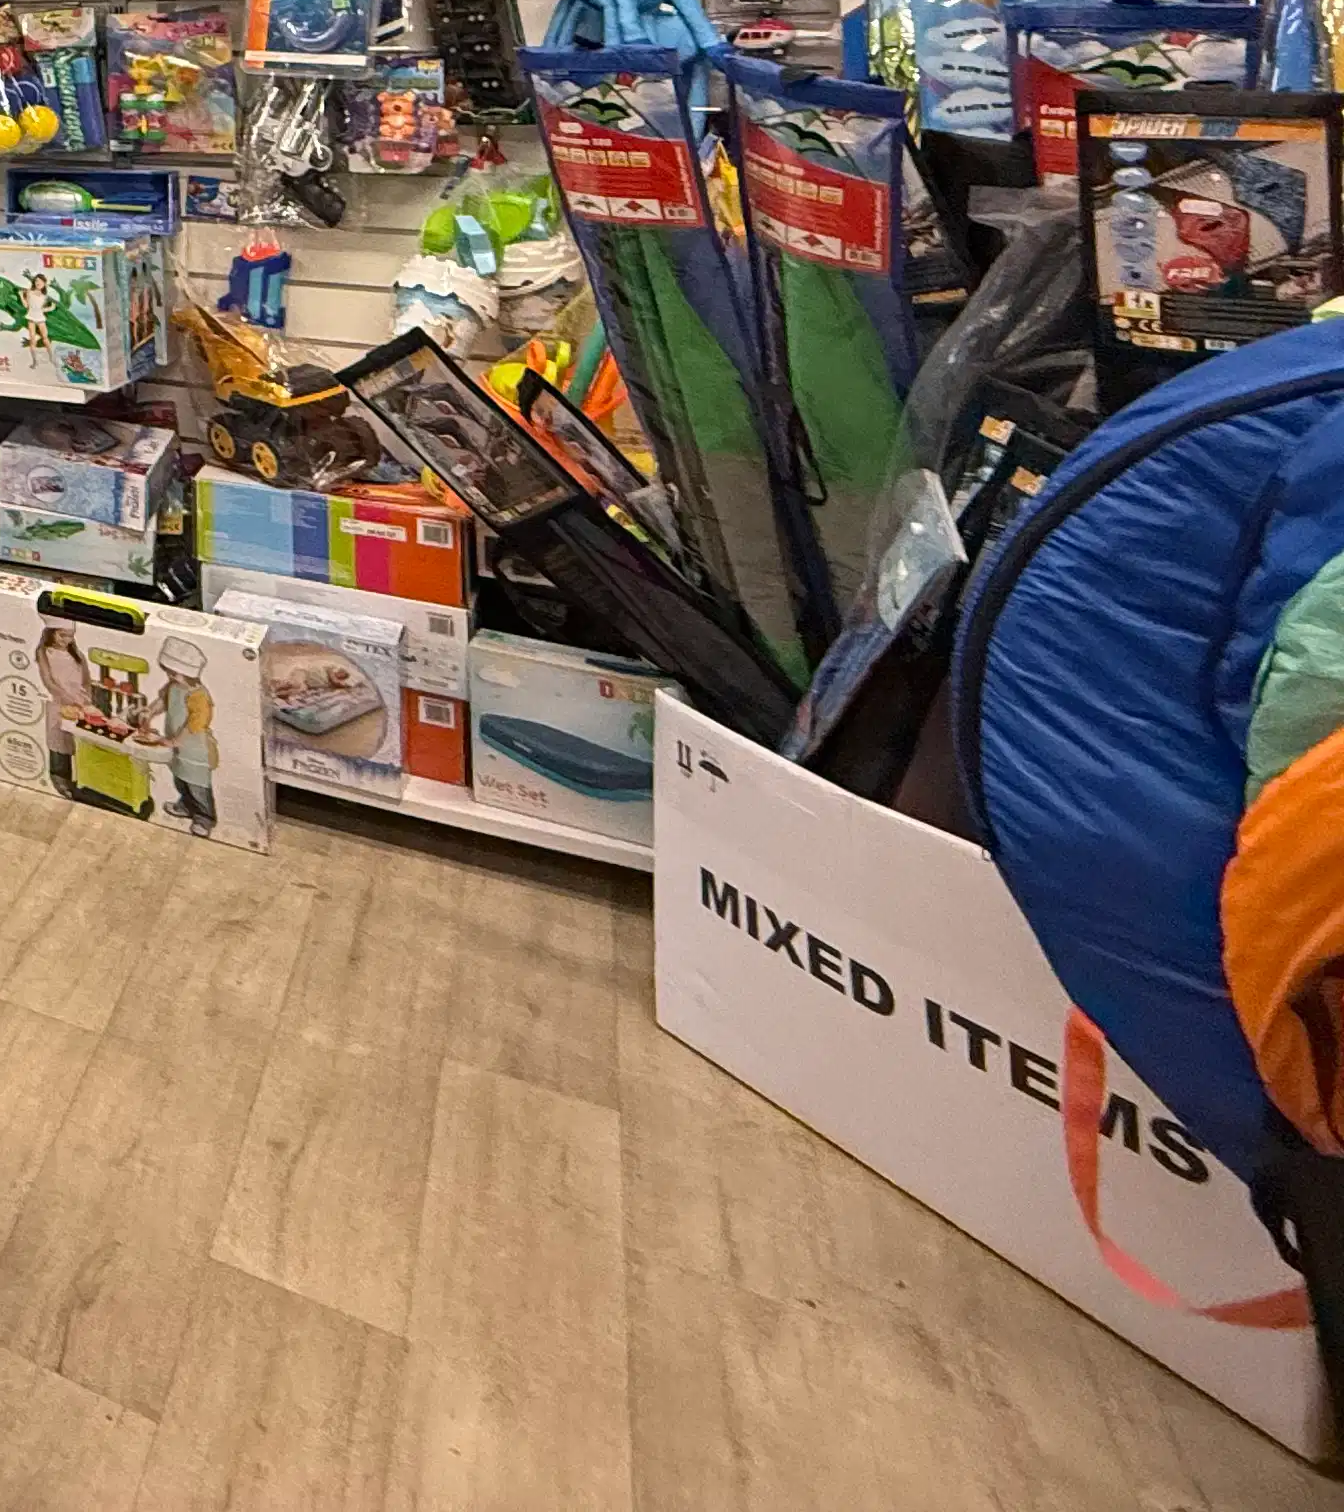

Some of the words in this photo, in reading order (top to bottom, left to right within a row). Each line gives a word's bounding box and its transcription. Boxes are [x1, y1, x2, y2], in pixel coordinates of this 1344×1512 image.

[12, 682, 28, 697] 15
[518, 785, 550, 804] Set
[699, 866, 897, 1017] MIXED
[923, 997, 1211, 1185] ITEMS
